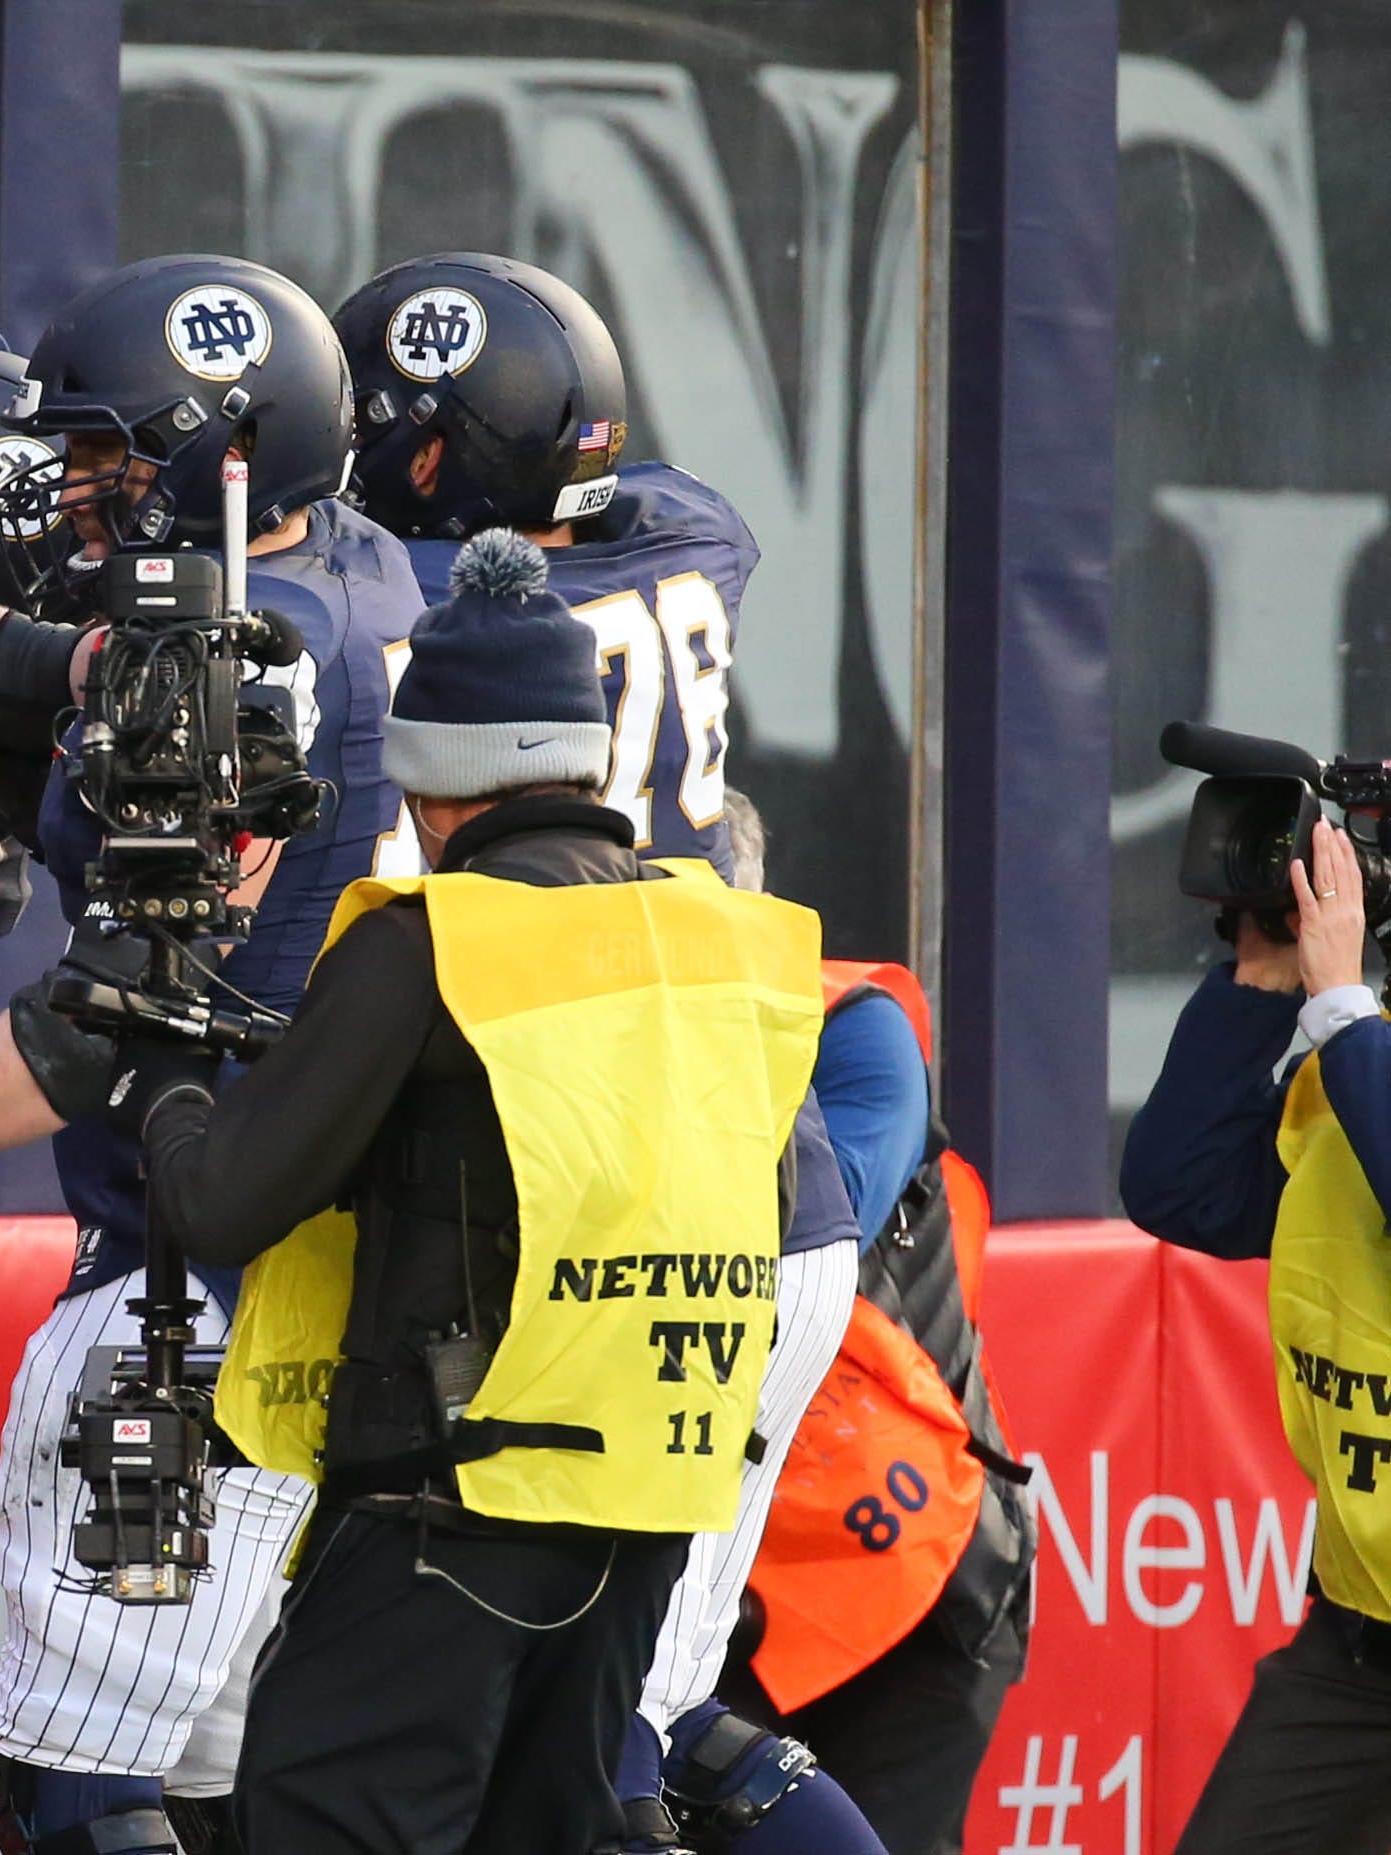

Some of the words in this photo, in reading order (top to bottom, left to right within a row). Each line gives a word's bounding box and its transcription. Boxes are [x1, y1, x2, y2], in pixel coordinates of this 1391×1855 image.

[570, 571, 732, 851] 78
[649, 1321, 745, 1384] TV
[666, 1410, 713, 1455] 11
[844, 1460, 929, 1552] 80
[1025, 1451, 1318, 1628] New
[998, 1735, 1143, 1855] #1
